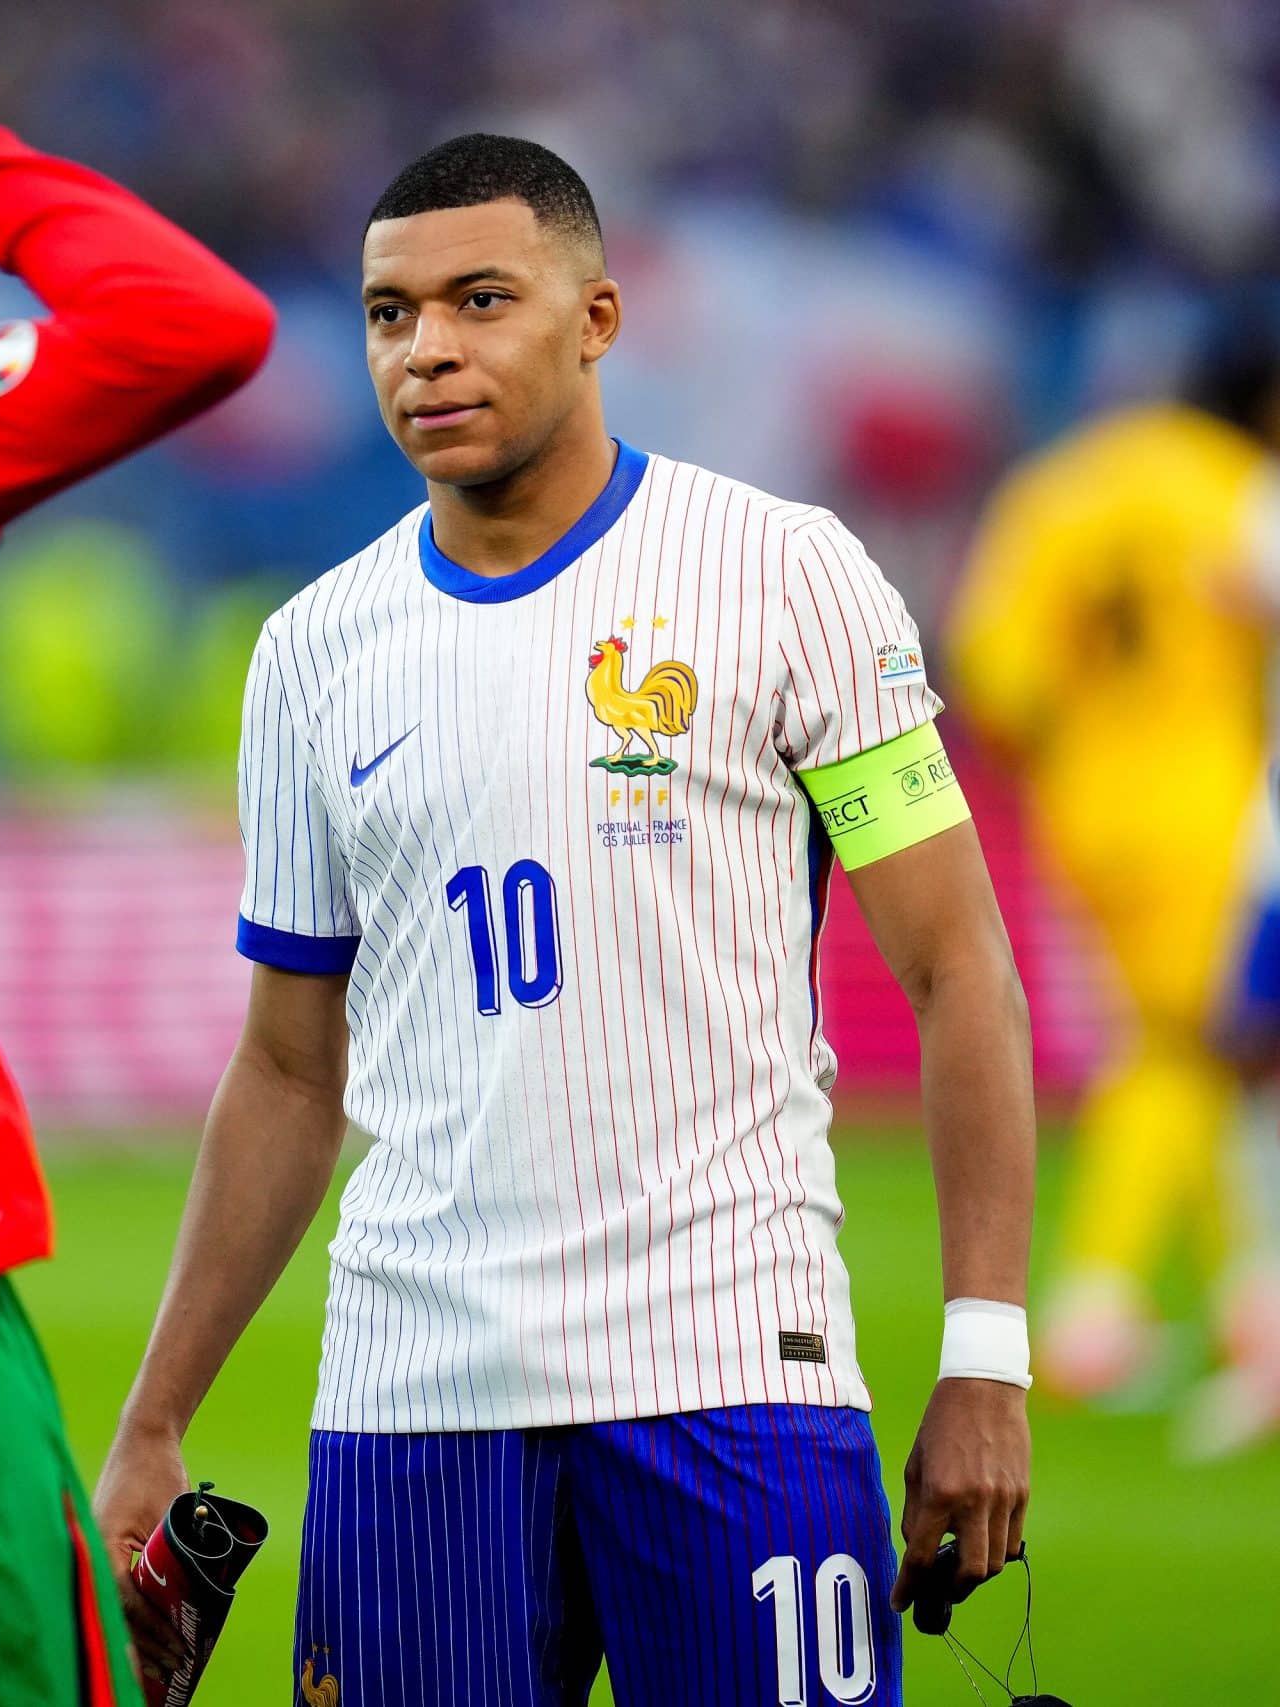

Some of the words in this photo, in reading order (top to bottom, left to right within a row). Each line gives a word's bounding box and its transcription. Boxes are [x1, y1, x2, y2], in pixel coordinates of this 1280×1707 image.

[877, 644, 898, 656] UEFA
[597, 820, 642, 835] PORTUGAL
[653, 819, 687, 831] FRANCE
[602, 835, 618, 848] 05
[622, 833, 651, 846] JUILLET
[654, 833, 683, 844] 2024
[446, 859, 563, 1016] 10
[752, 1553, 876, 1707] 10
